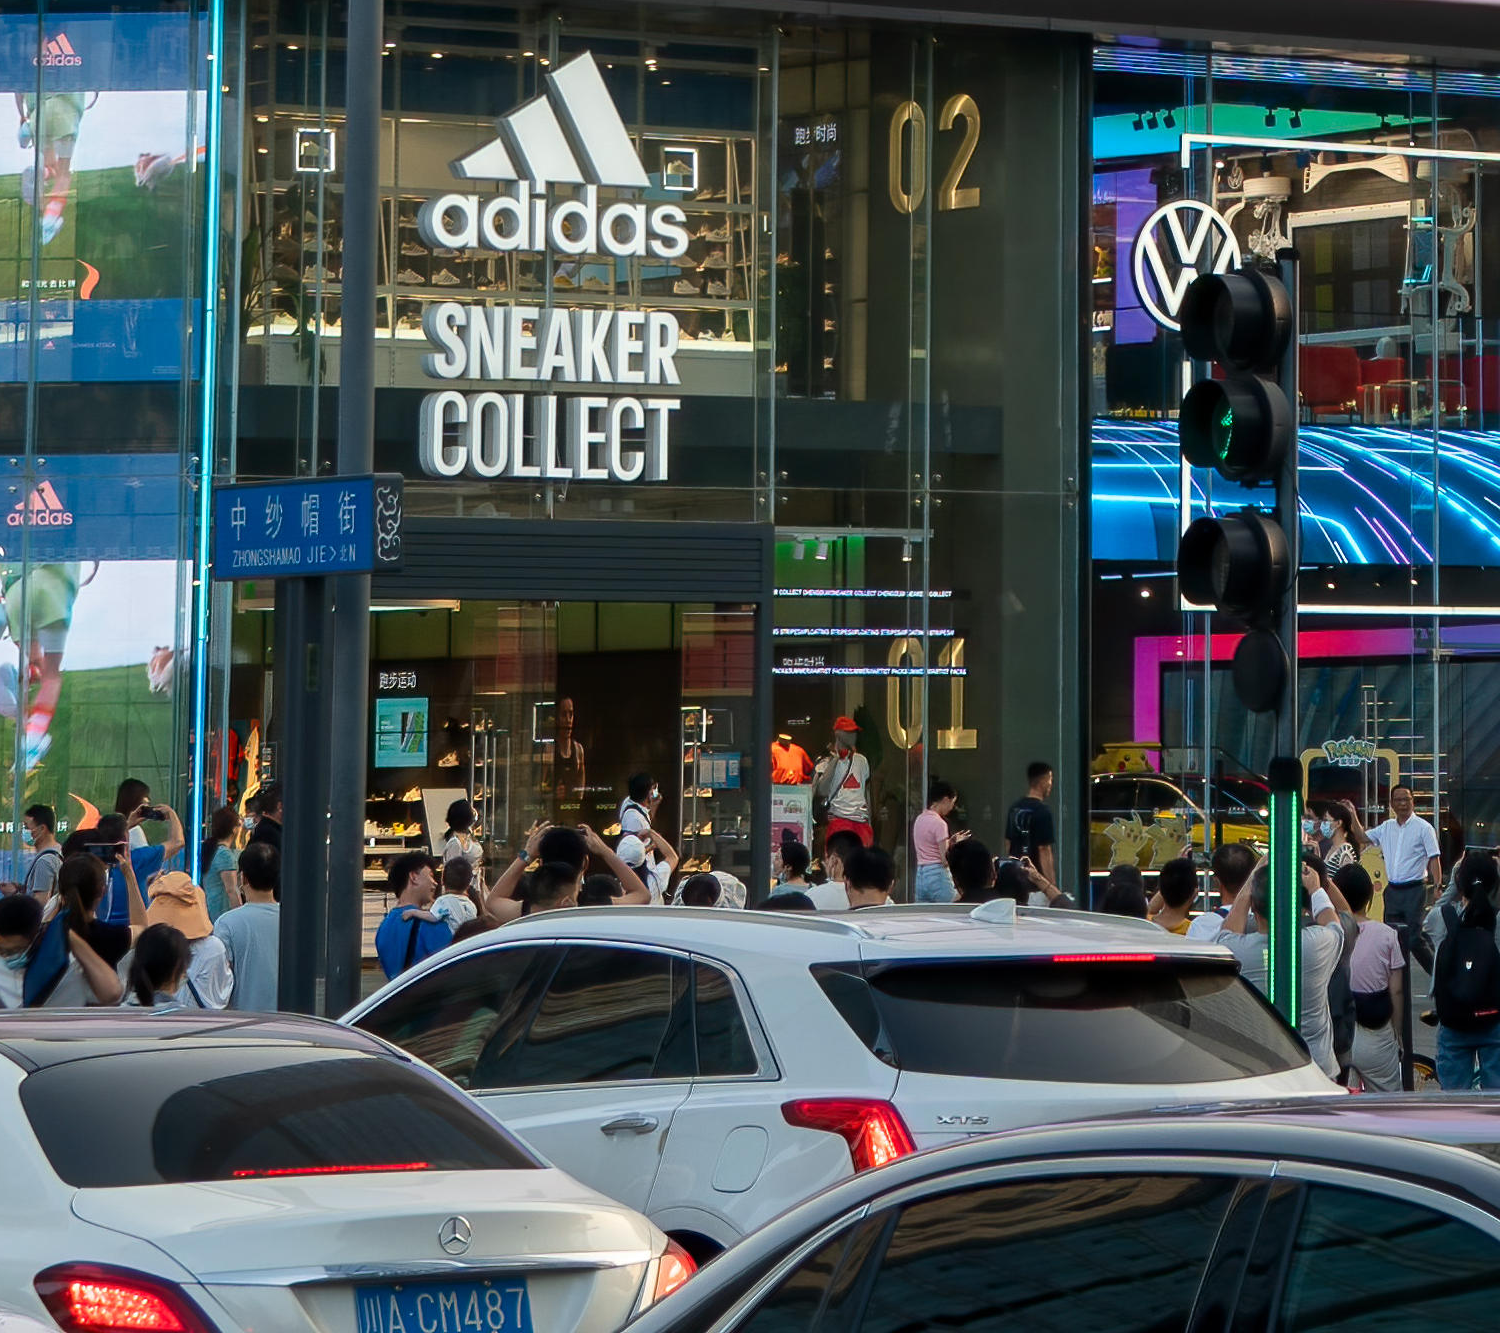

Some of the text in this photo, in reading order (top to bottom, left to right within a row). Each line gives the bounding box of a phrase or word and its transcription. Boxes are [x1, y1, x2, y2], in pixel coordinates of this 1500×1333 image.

[889, 93, 980, 214] 02
[425, 180, 690, 259] adidas
[429, 302, 681, 385] SNEAKER
[428, 390, 681, 482] COLLECT
[230, 490, 357, 542] 中纱帽街
[232, 546, 301, 568] ZHONGSHAMAO
[887, 637, 978, 750] 01
